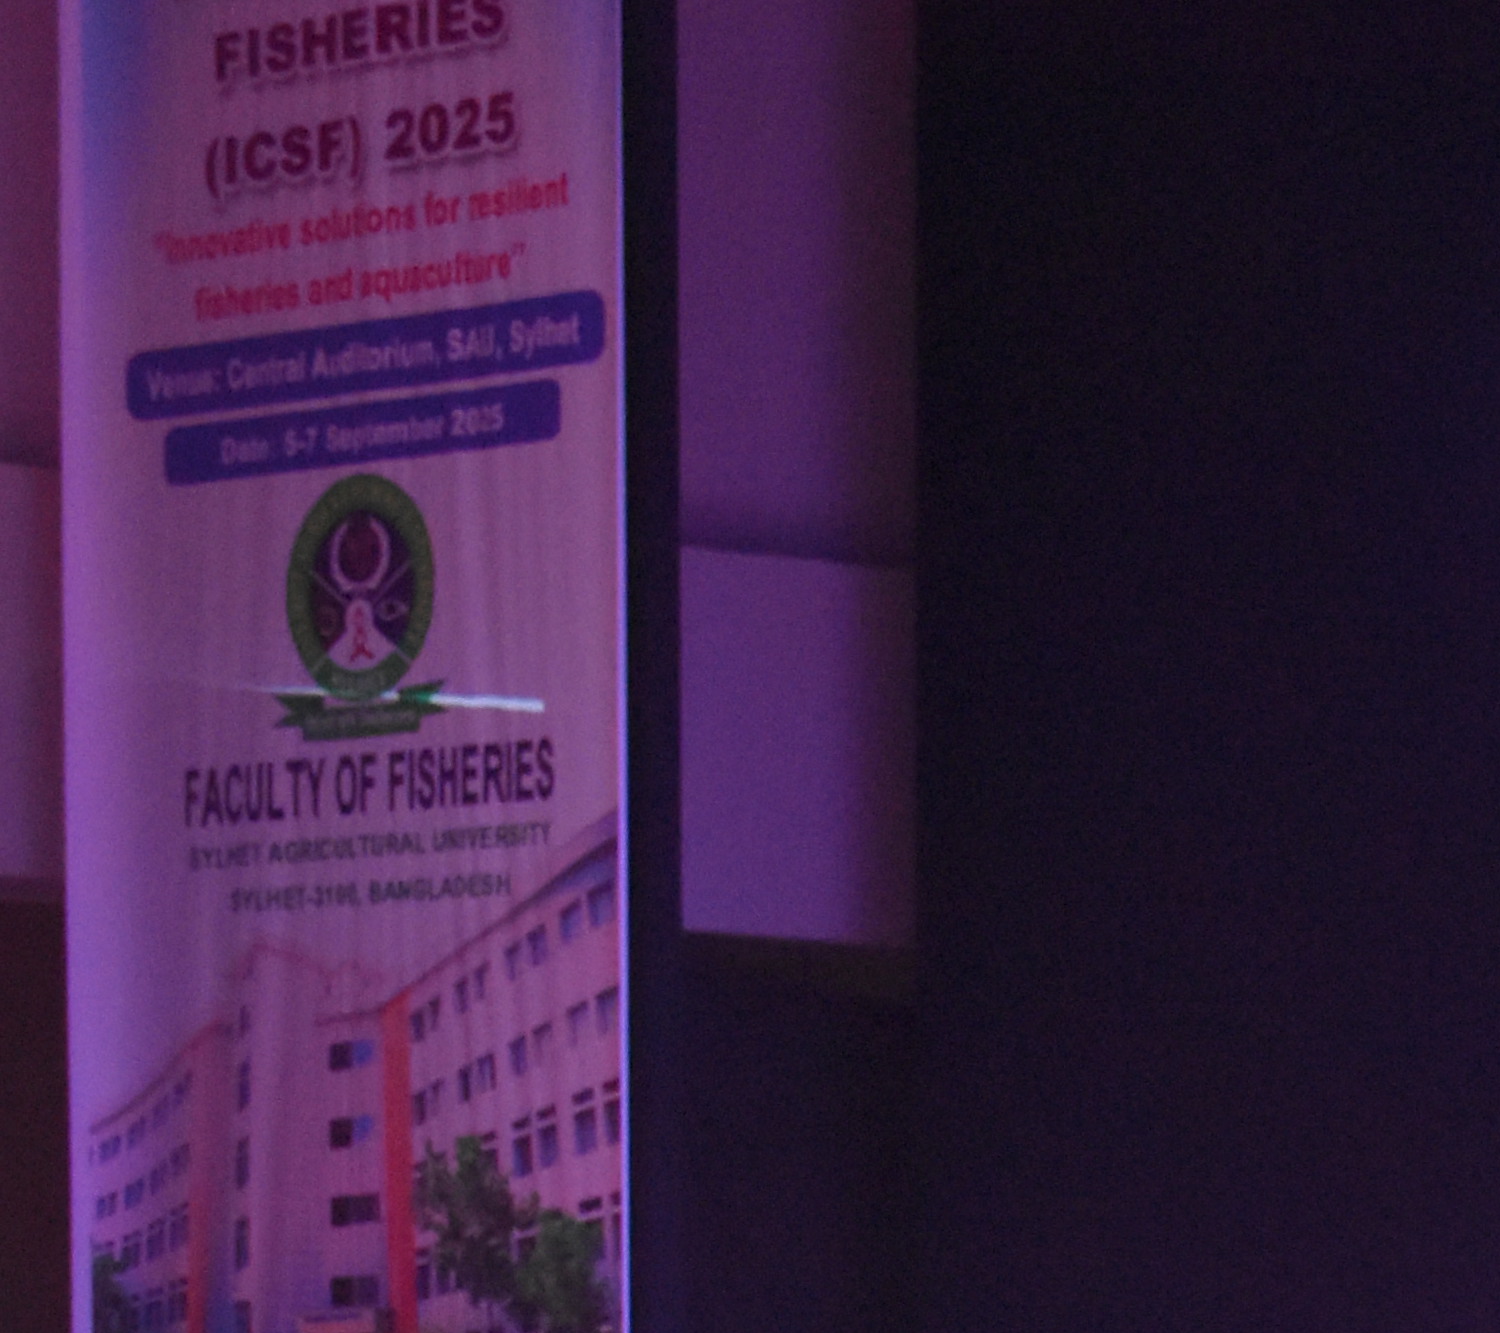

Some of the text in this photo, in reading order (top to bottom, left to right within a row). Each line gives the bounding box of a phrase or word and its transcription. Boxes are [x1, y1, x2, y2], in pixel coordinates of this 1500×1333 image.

[215, 0, 506, 82] FISHERIES
[204, 91, 516, 199] (ICSF) 2025
[300, 200, 416, 247] solutions
[424, 189, 460, 225] for
[467, 172, 569, 221] resilient
[194, 278, 301, 322] fisheries
[308, 268, 354, 303] and
[147, 313, 581, 402] Venue: Central Auditorium, SAU, Sylhet
[326, 414, 443, 453] September
[450, 405, 504, 435] 2025
[183, 737, 556, 827] FACULTY OF FISHERIES
[188, 822, 552, 871] SYLHET AGRICULTURAL UNIVERSITY
[370, 873, 513, 904] BANGLADESH
